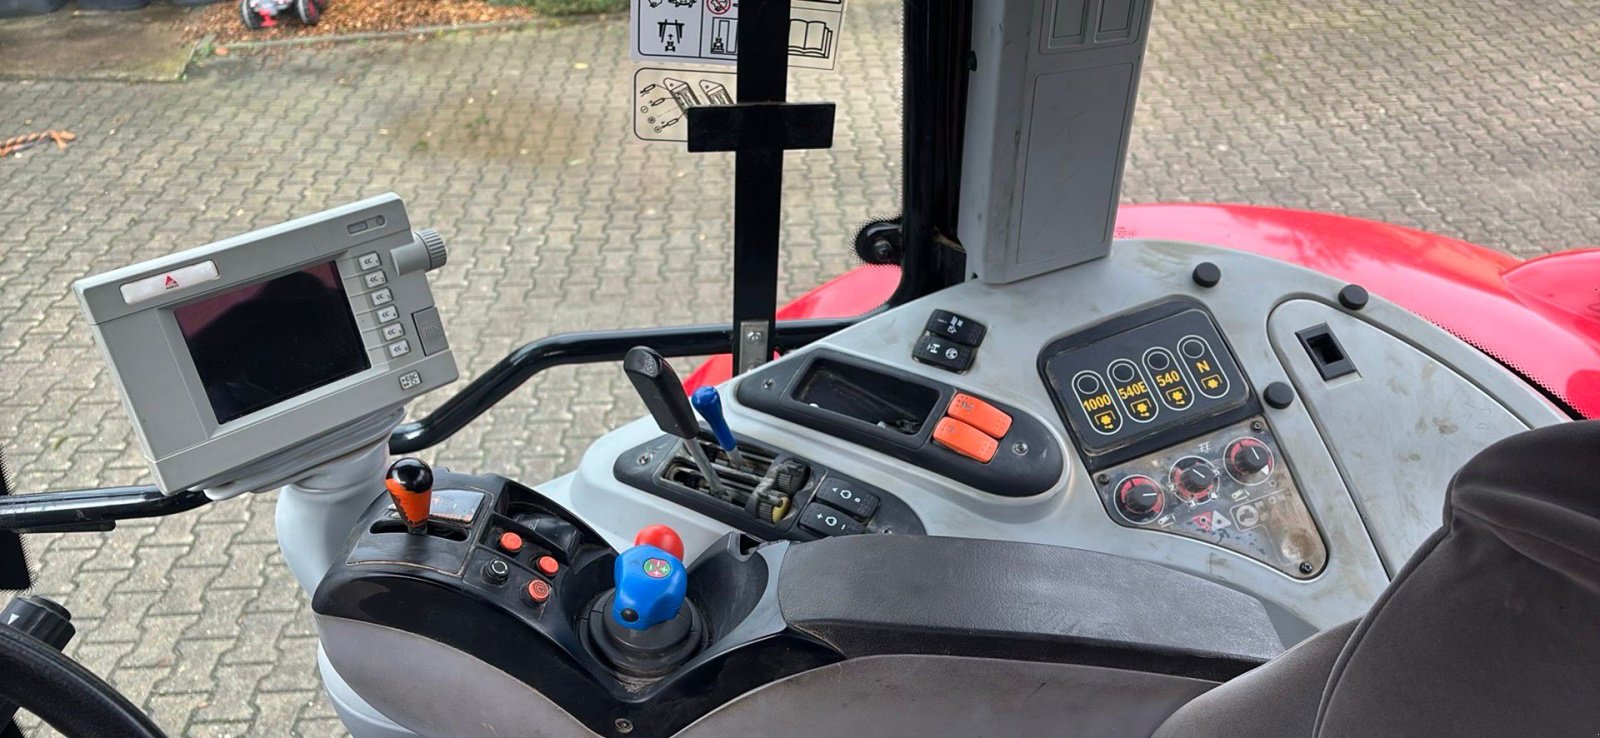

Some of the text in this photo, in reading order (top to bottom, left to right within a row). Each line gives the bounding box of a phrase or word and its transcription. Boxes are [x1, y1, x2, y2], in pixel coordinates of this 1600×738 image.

[1196, 360, 1211, 373] N
[1155, 370, 1181, 387] 540
[1118, 381, 1148, 400] 540E
[1083, 394, 1112, 412] 1000
